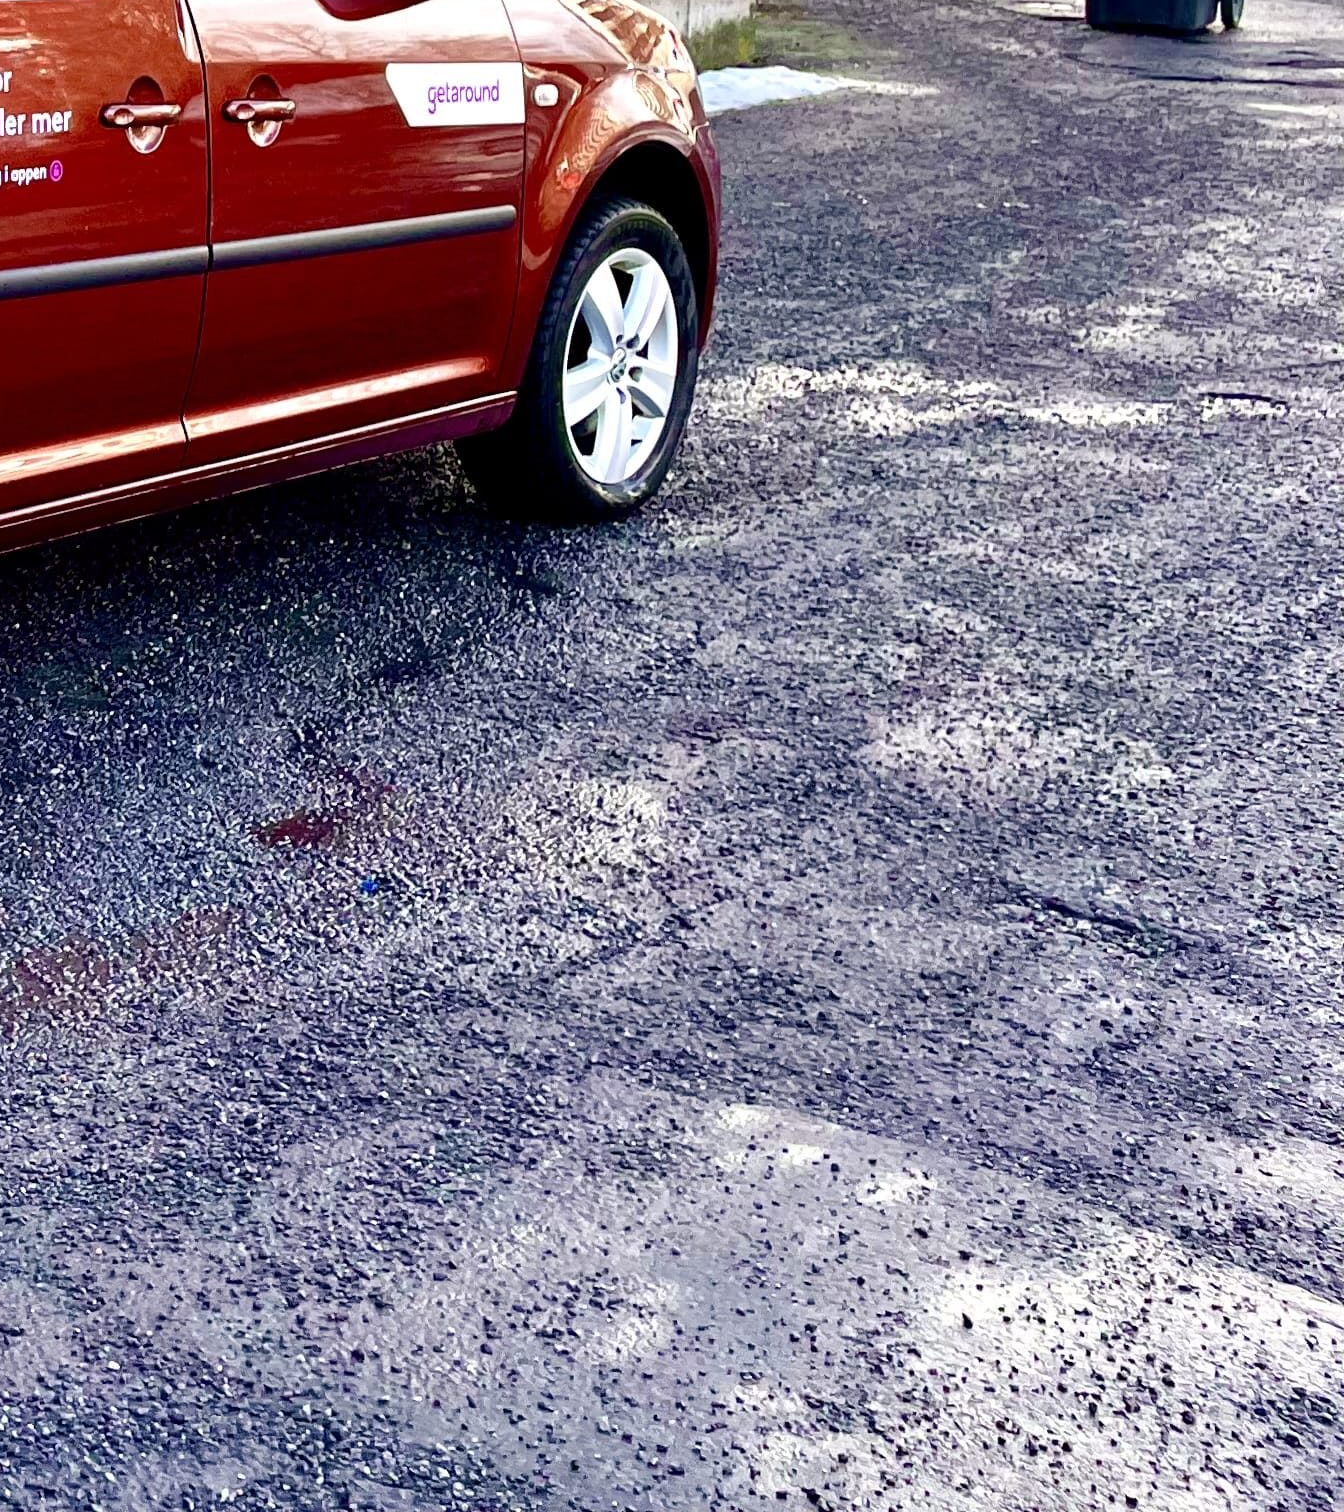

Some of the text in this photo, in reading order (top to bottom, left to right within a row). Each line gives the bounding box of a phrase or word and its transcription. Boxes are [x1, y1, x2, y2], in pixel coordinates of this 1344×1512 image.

[427, 79, 501, 114] getaround
[31, 110, 73, 134] mer
[4, 165, 9, 183] i
[10, 166, 48, 186] appen
